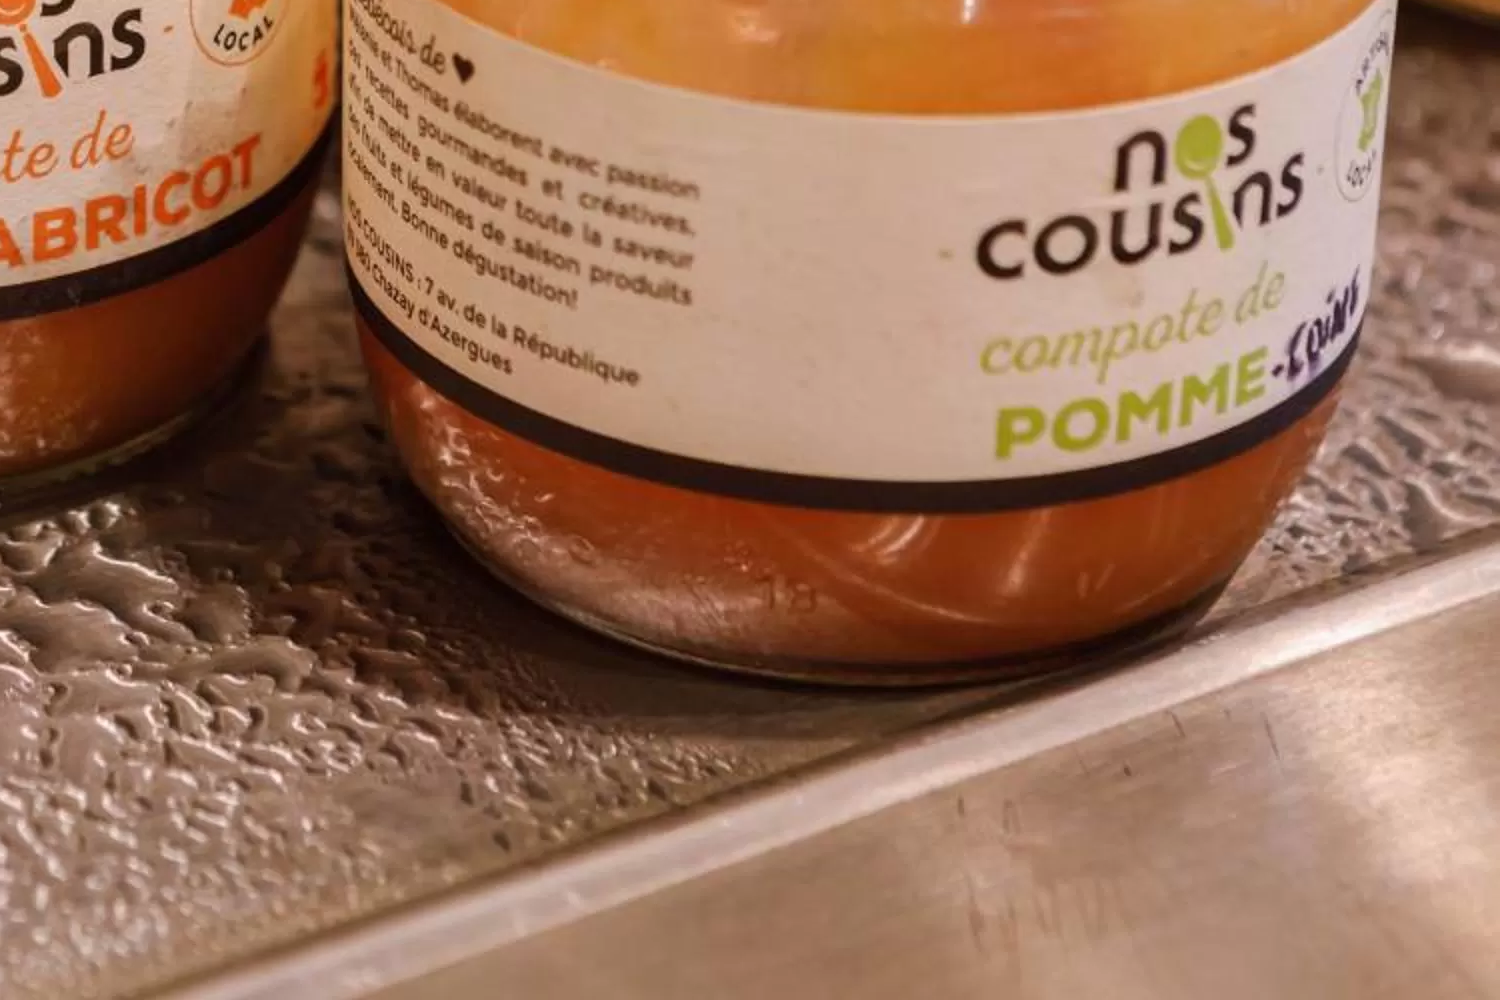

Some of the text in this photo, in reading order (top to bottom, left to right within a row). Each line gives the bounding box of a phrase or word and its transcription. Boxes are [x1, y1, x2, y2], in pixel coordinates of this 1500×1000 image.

[213, 15, 274, 51] LOCAL
[420, 33, 447, 75] de
[70, 108, 135, 169] de
[396, 58, 450, 113] Thomas
[454, 101, 543, 158] élaborent
[549, 145, 600, 177] avec
[607, 164, 701, 200] passion
[418, 115, 528, 187] gourmandes
[541, 179, 564, 201] et
[378, 115, 421, 162] mettre
[426, 155, 445, 181] en
[452, 169, 507, 210] valeur
[515, 199, 574, 238] toute
[582, 221, 603, 248] la
[613, 236, 694, 271] saveur
[390, 161, 403, 184] et
[407, 169, 474, 230] légumes
[481, 219, 506, 246] de
[512, 237, 581, 276] saison
[589, 264, 693, 307] produits
[401, 200, 449, 249] Bonne
[976, 152, 1304, 279] cousins
[363, 218, 414, 283] COUSINS
[424, 276, 435, 296] 7
[437, 288, 460, 316] av.
[463, 304, 488, 329] de
[491, 313, 508, 340] la
[513, 325, 641, 387] République
[372, 263, 416, 319] Chazay
[418, 306, 514, 375] d'Azergues
[980, 259, 1286, 384] compote de
[995, 346, 1269, 460] POMME
